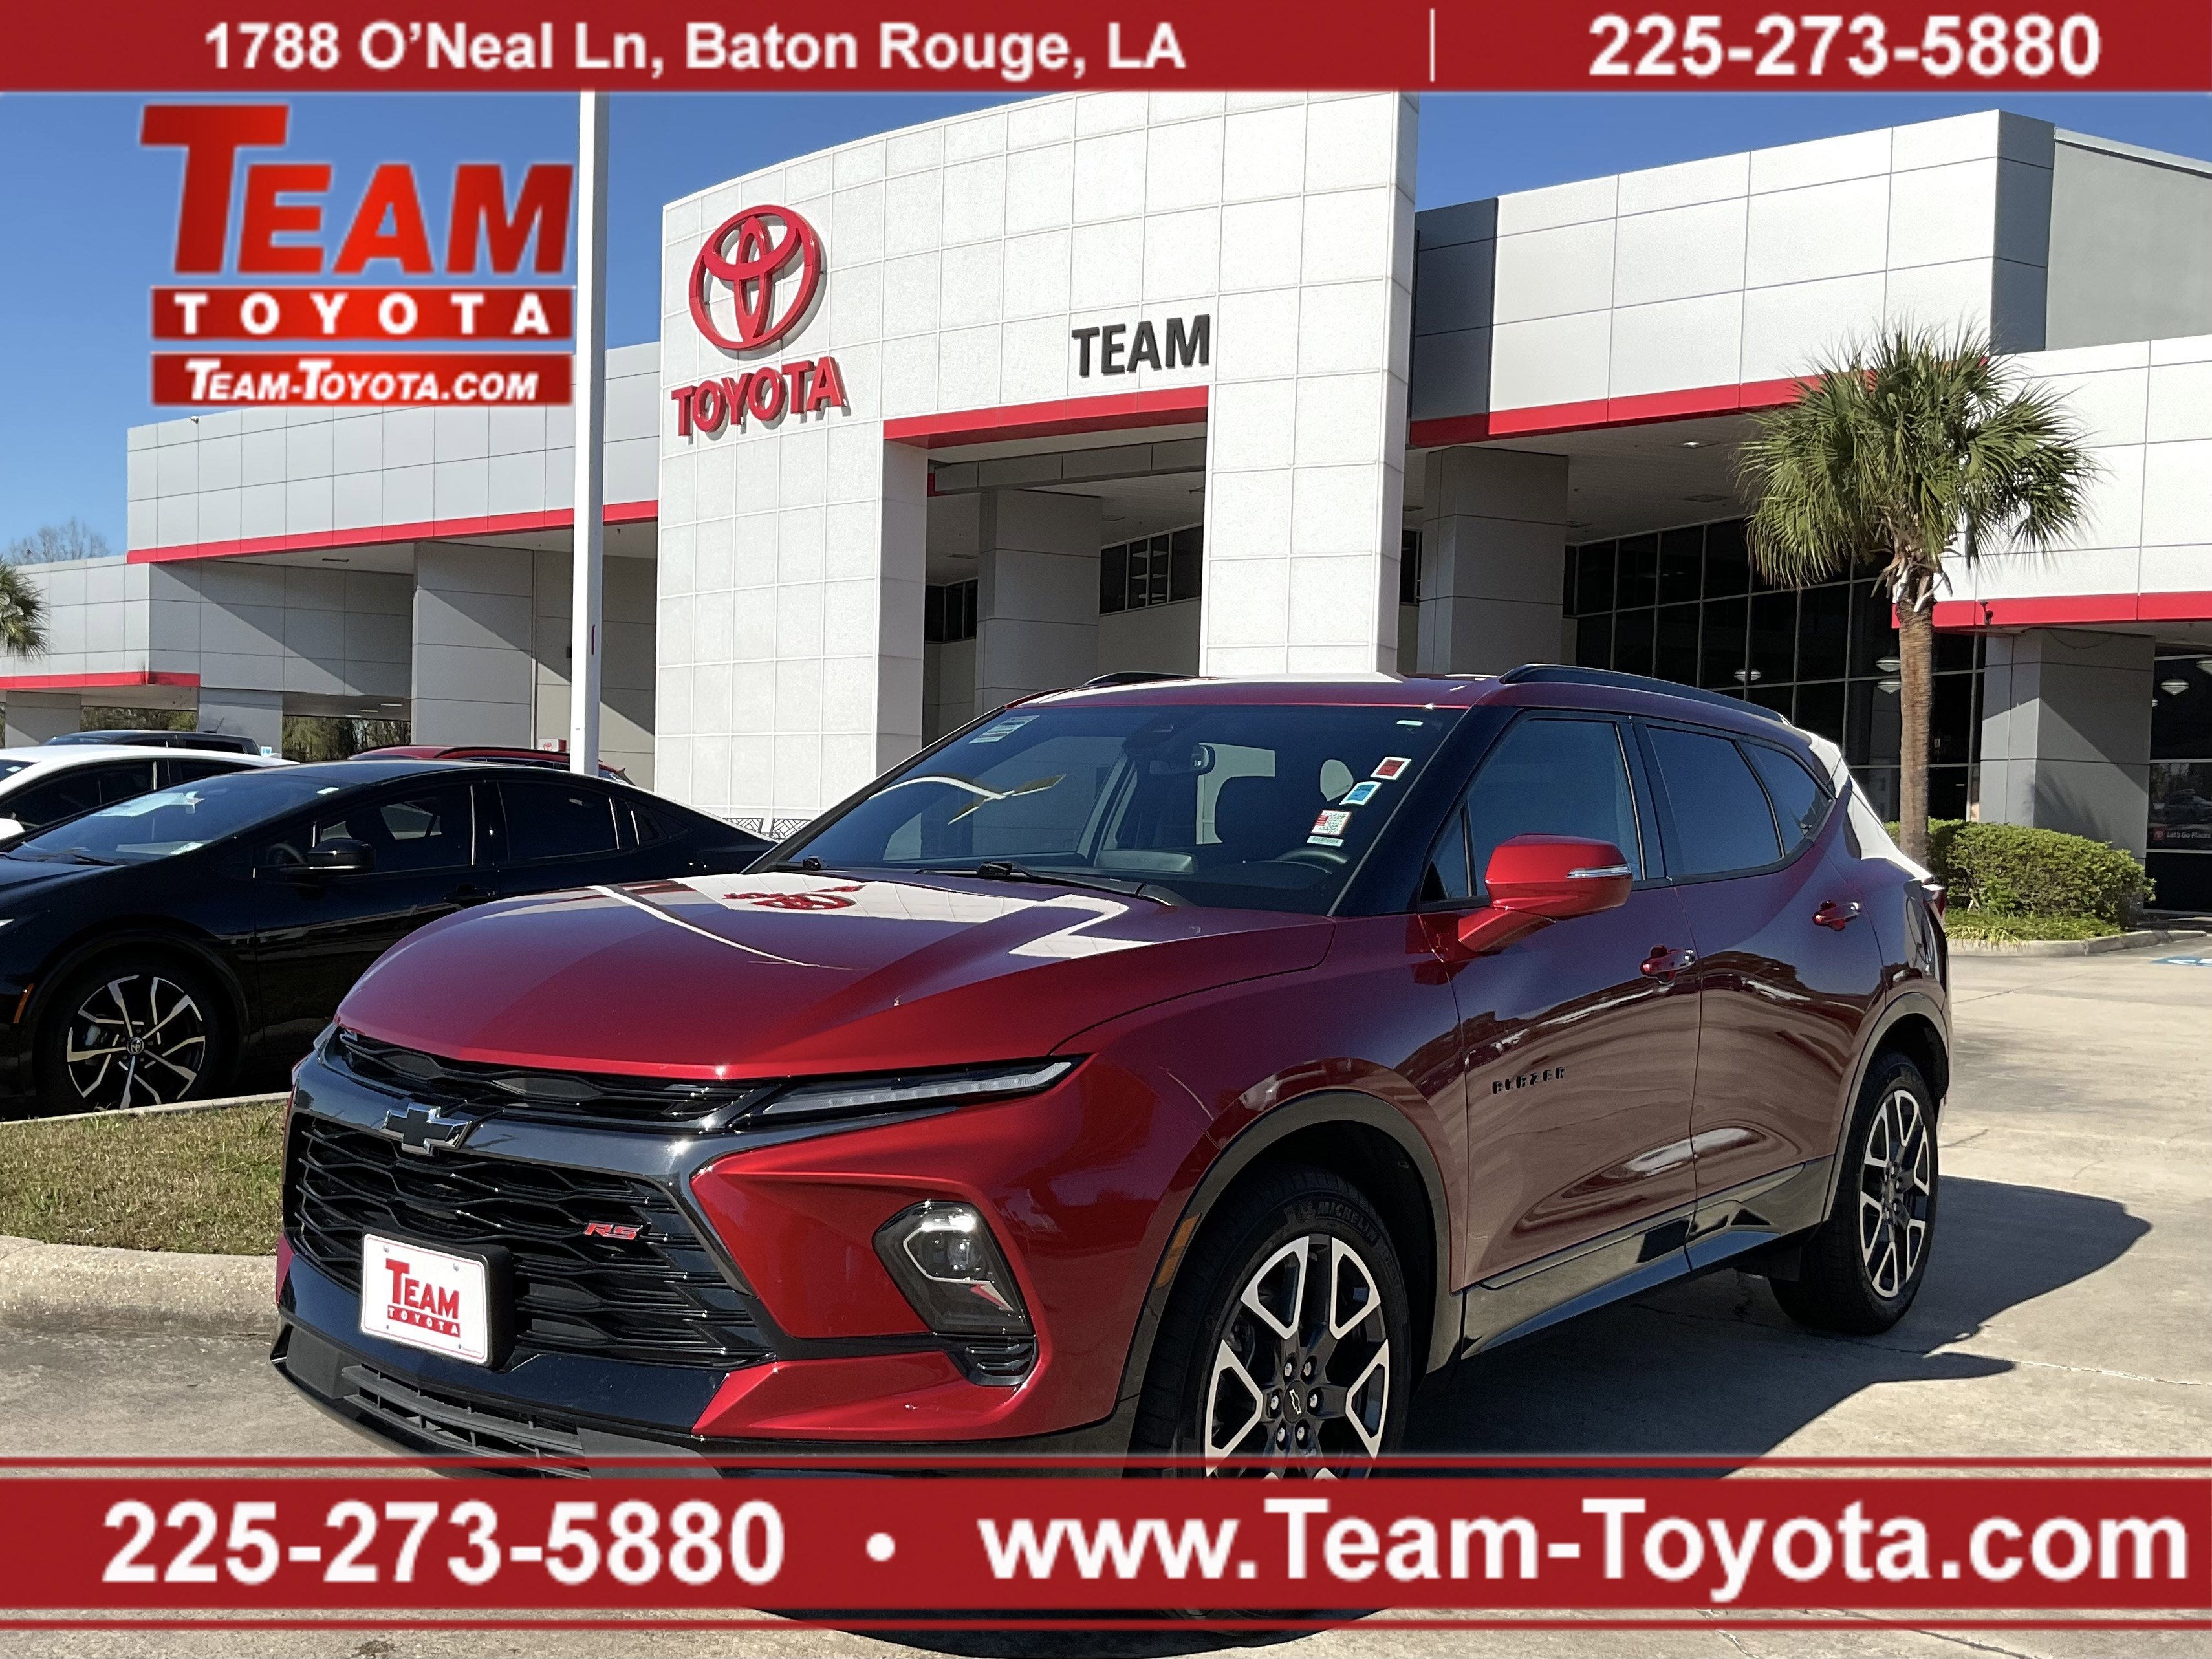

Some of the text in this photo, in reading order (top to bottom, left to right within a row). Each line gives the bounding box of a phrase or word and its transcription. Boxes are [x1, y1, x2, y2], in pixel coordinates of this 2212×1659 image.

[1070, 314, 1210, 377] TEAM
[671, 356, 847, 437] TOYOTA
[584, 1221, 642, 1241] RS
[385, 1257, 460, 1320] TEAM
[388, 1307, 459, 1335] TOYOTA
